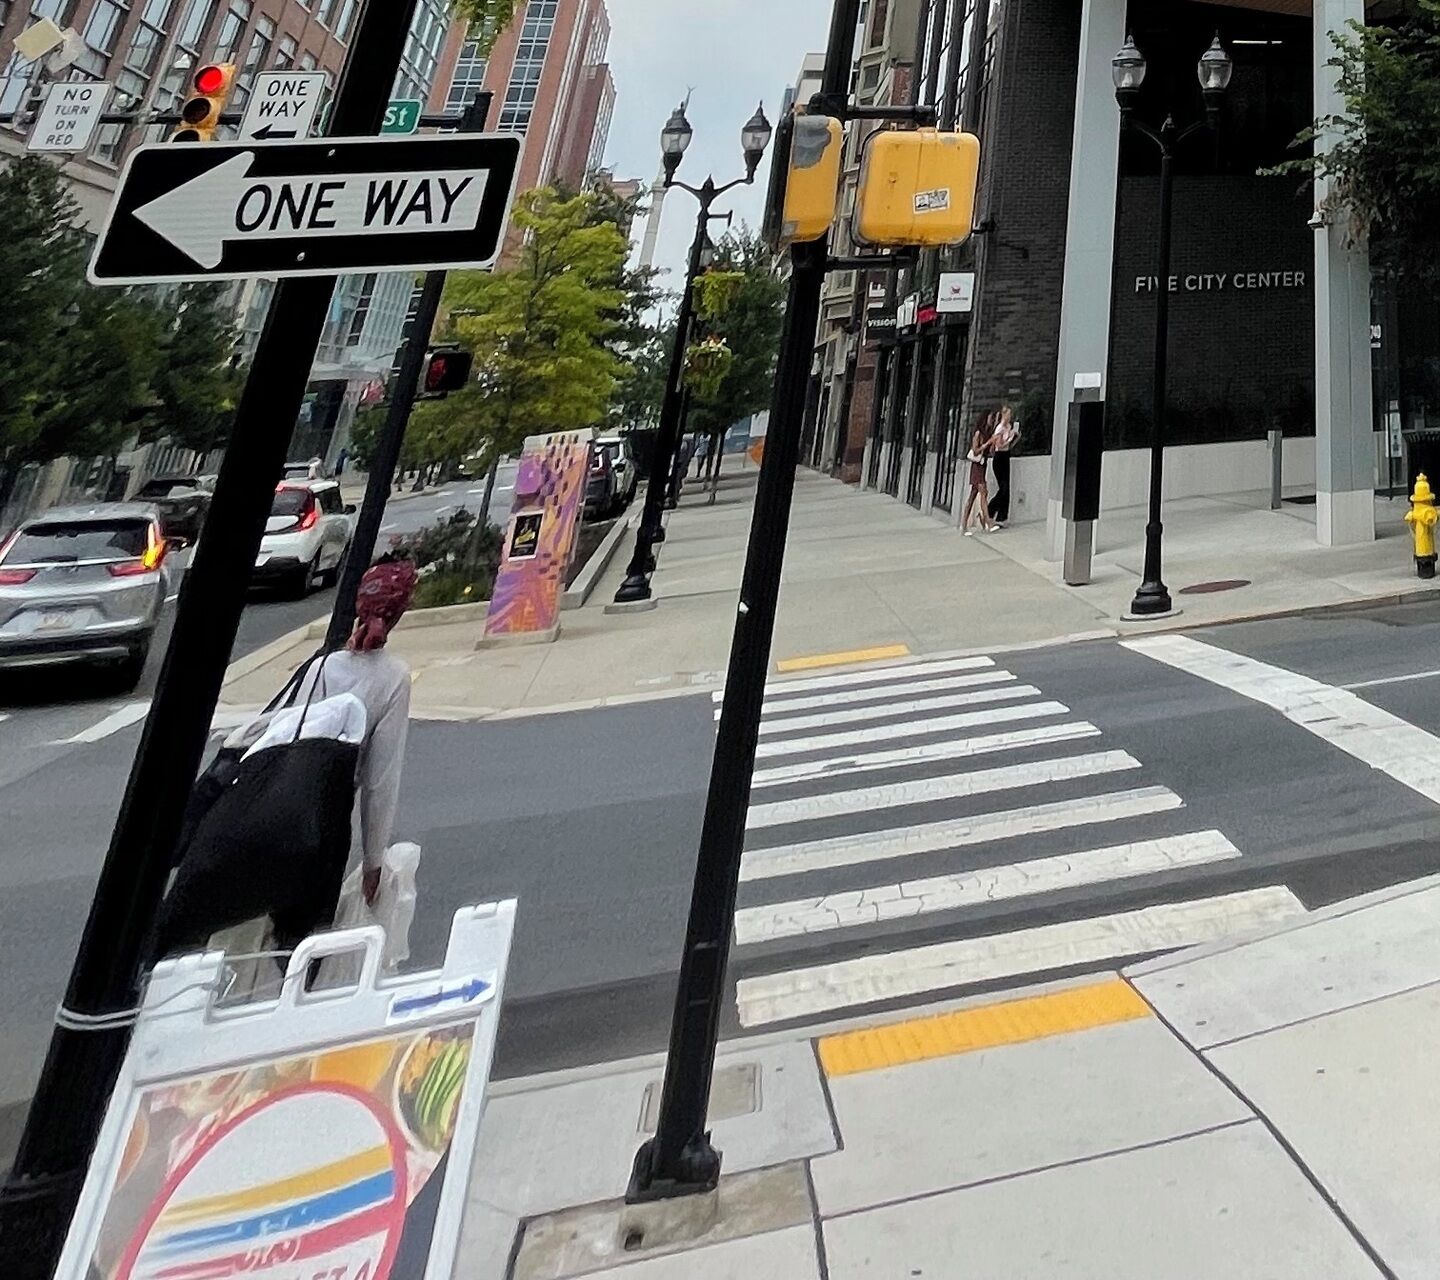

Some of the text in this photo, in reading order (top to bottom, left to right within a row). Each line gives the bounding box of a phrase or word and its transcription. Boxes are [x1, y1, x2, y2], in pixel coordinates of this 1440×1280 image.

[63, 88, 93, 101] NO
[267, 80, 310, 97] ONE
[55, 104, 90, 116] TURN
[259, 101, 306, 117] WAY
[382, 105, 408, 126] St
[55, 120, 76, 130] ON
[45, 134, 73, 146] RED
[235, 176, 474, 232] ONE WAY
[1184, 273, 1228, 291] CITY
[1232, 271, 1306, 289] CENTER
